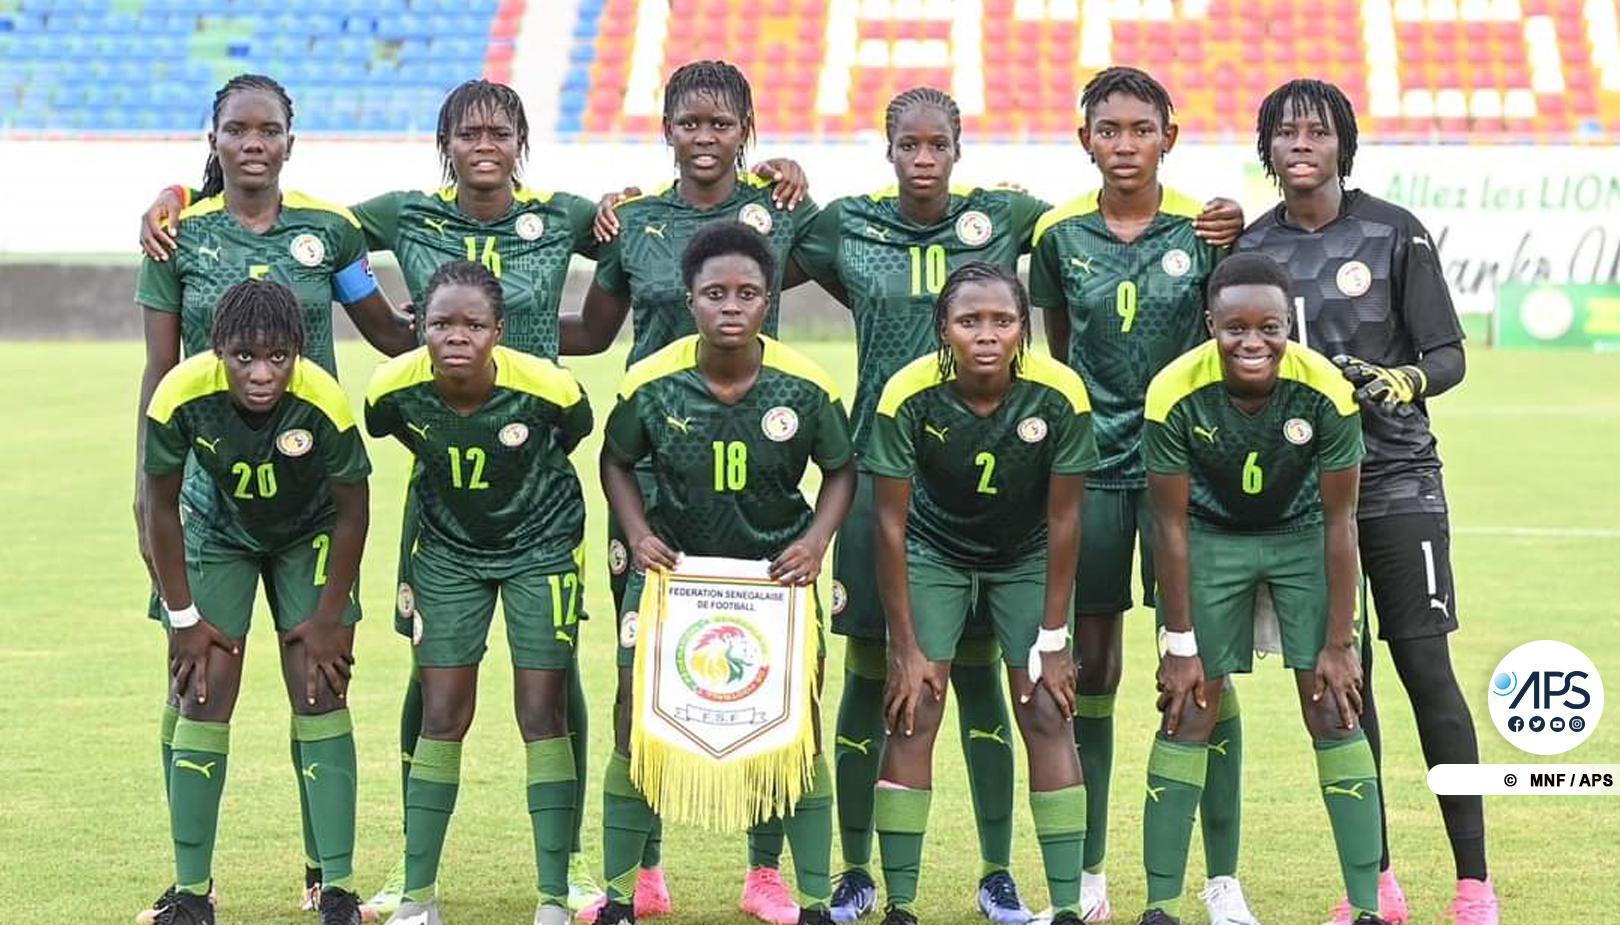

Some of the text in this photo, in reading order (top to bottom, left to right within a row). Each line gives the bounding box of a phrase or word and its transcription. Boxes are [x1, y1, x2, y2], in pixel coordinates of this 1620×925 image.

[1385, 171, 1468, 210] Allez
[1480, 175, 1527, 210] les
[909, 245, 946, 296] 10
[1117, 281, 1137, 333] 9
[231, 461, 278, 499] 20
[448, 446, 490, 490] 12
[712, 440, 748, 491] 18
[975, 452, 998, 494] 2
[1242, 451, 1263, 494] 6
[1421, 540, 1437, 595] 1
[548, 572, 578, 627] 12
[697, 600, 756, 612] DE FOOTBALL
